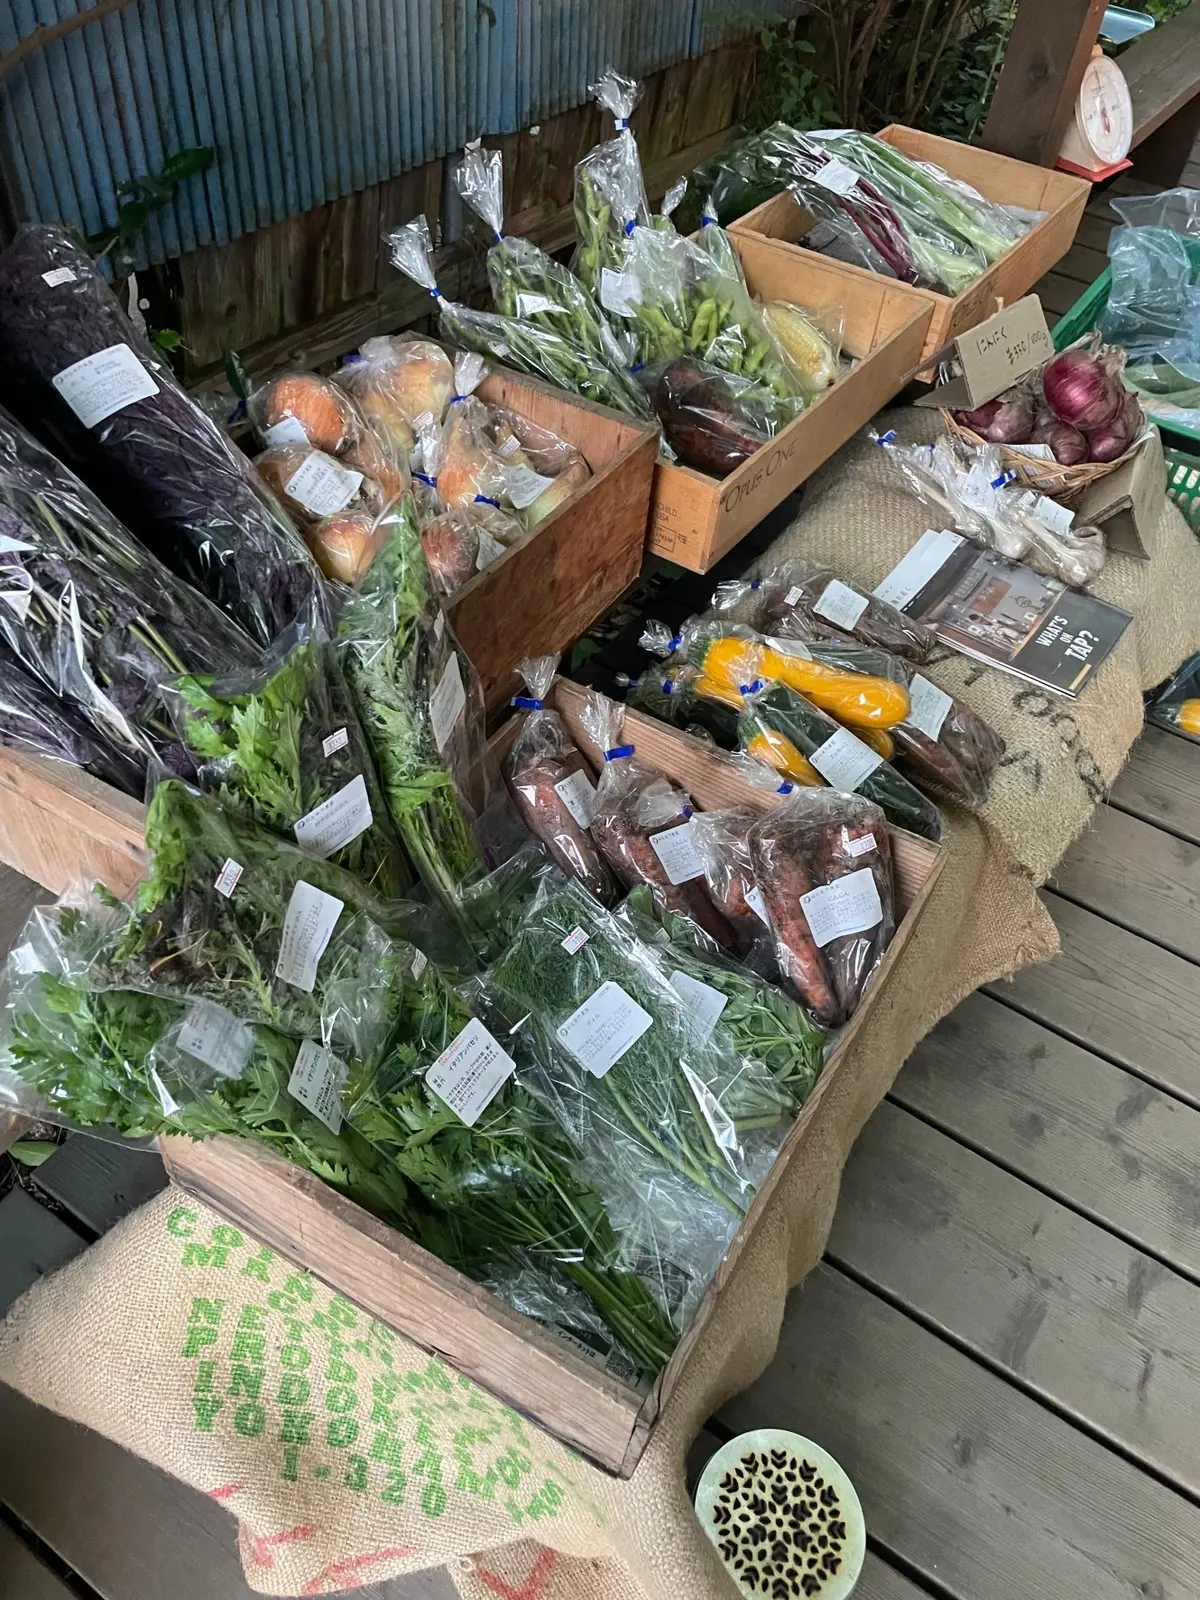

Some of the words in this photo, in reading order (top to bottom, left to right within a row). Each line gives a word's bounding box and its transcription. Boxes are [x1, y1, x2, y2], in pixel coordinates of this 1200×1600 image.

[976, 326, 1007, 355] にんにく
[725, 468, 764, 513] OPUS
[1035, 615, 1069, 648] WHAT'S
[1059, 631, 1075, 643] ON
[1065, 630, 1101, 662] TAP?
[446, 1033, 479, 1073] イタリアンパセリ
